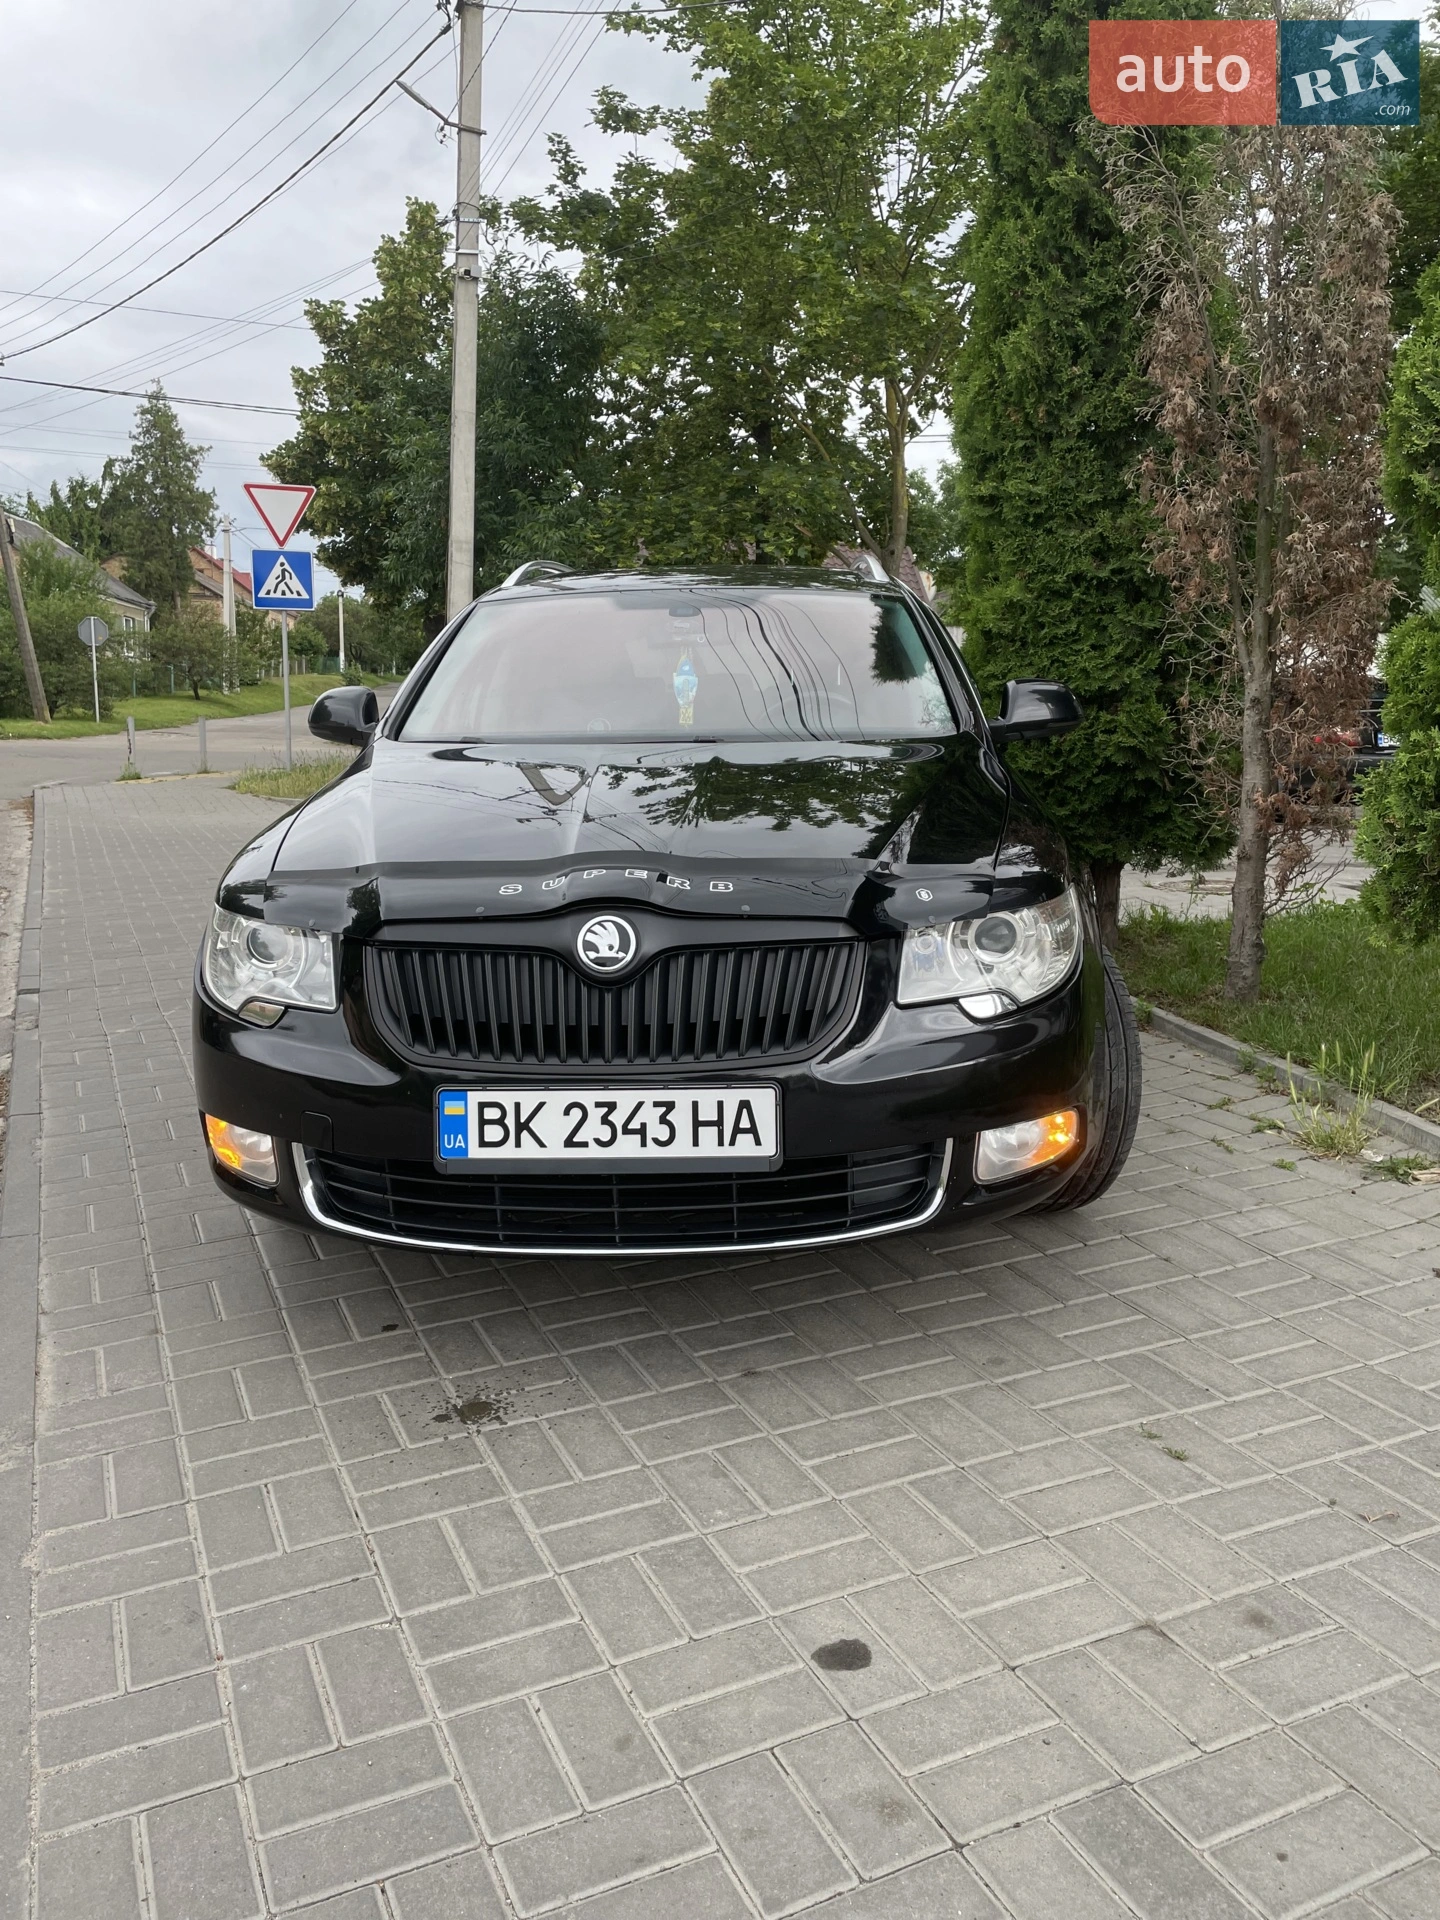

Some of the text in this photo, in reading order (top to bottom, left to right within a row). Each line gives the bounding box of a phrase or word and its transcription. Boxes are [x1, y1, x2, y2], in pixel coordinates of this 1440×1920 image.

[499, 869, 733, 894] SUPERB
[477, 1099, 762, 1148] BK 2343 HA
[444, 1134, 465, 1148] UA
